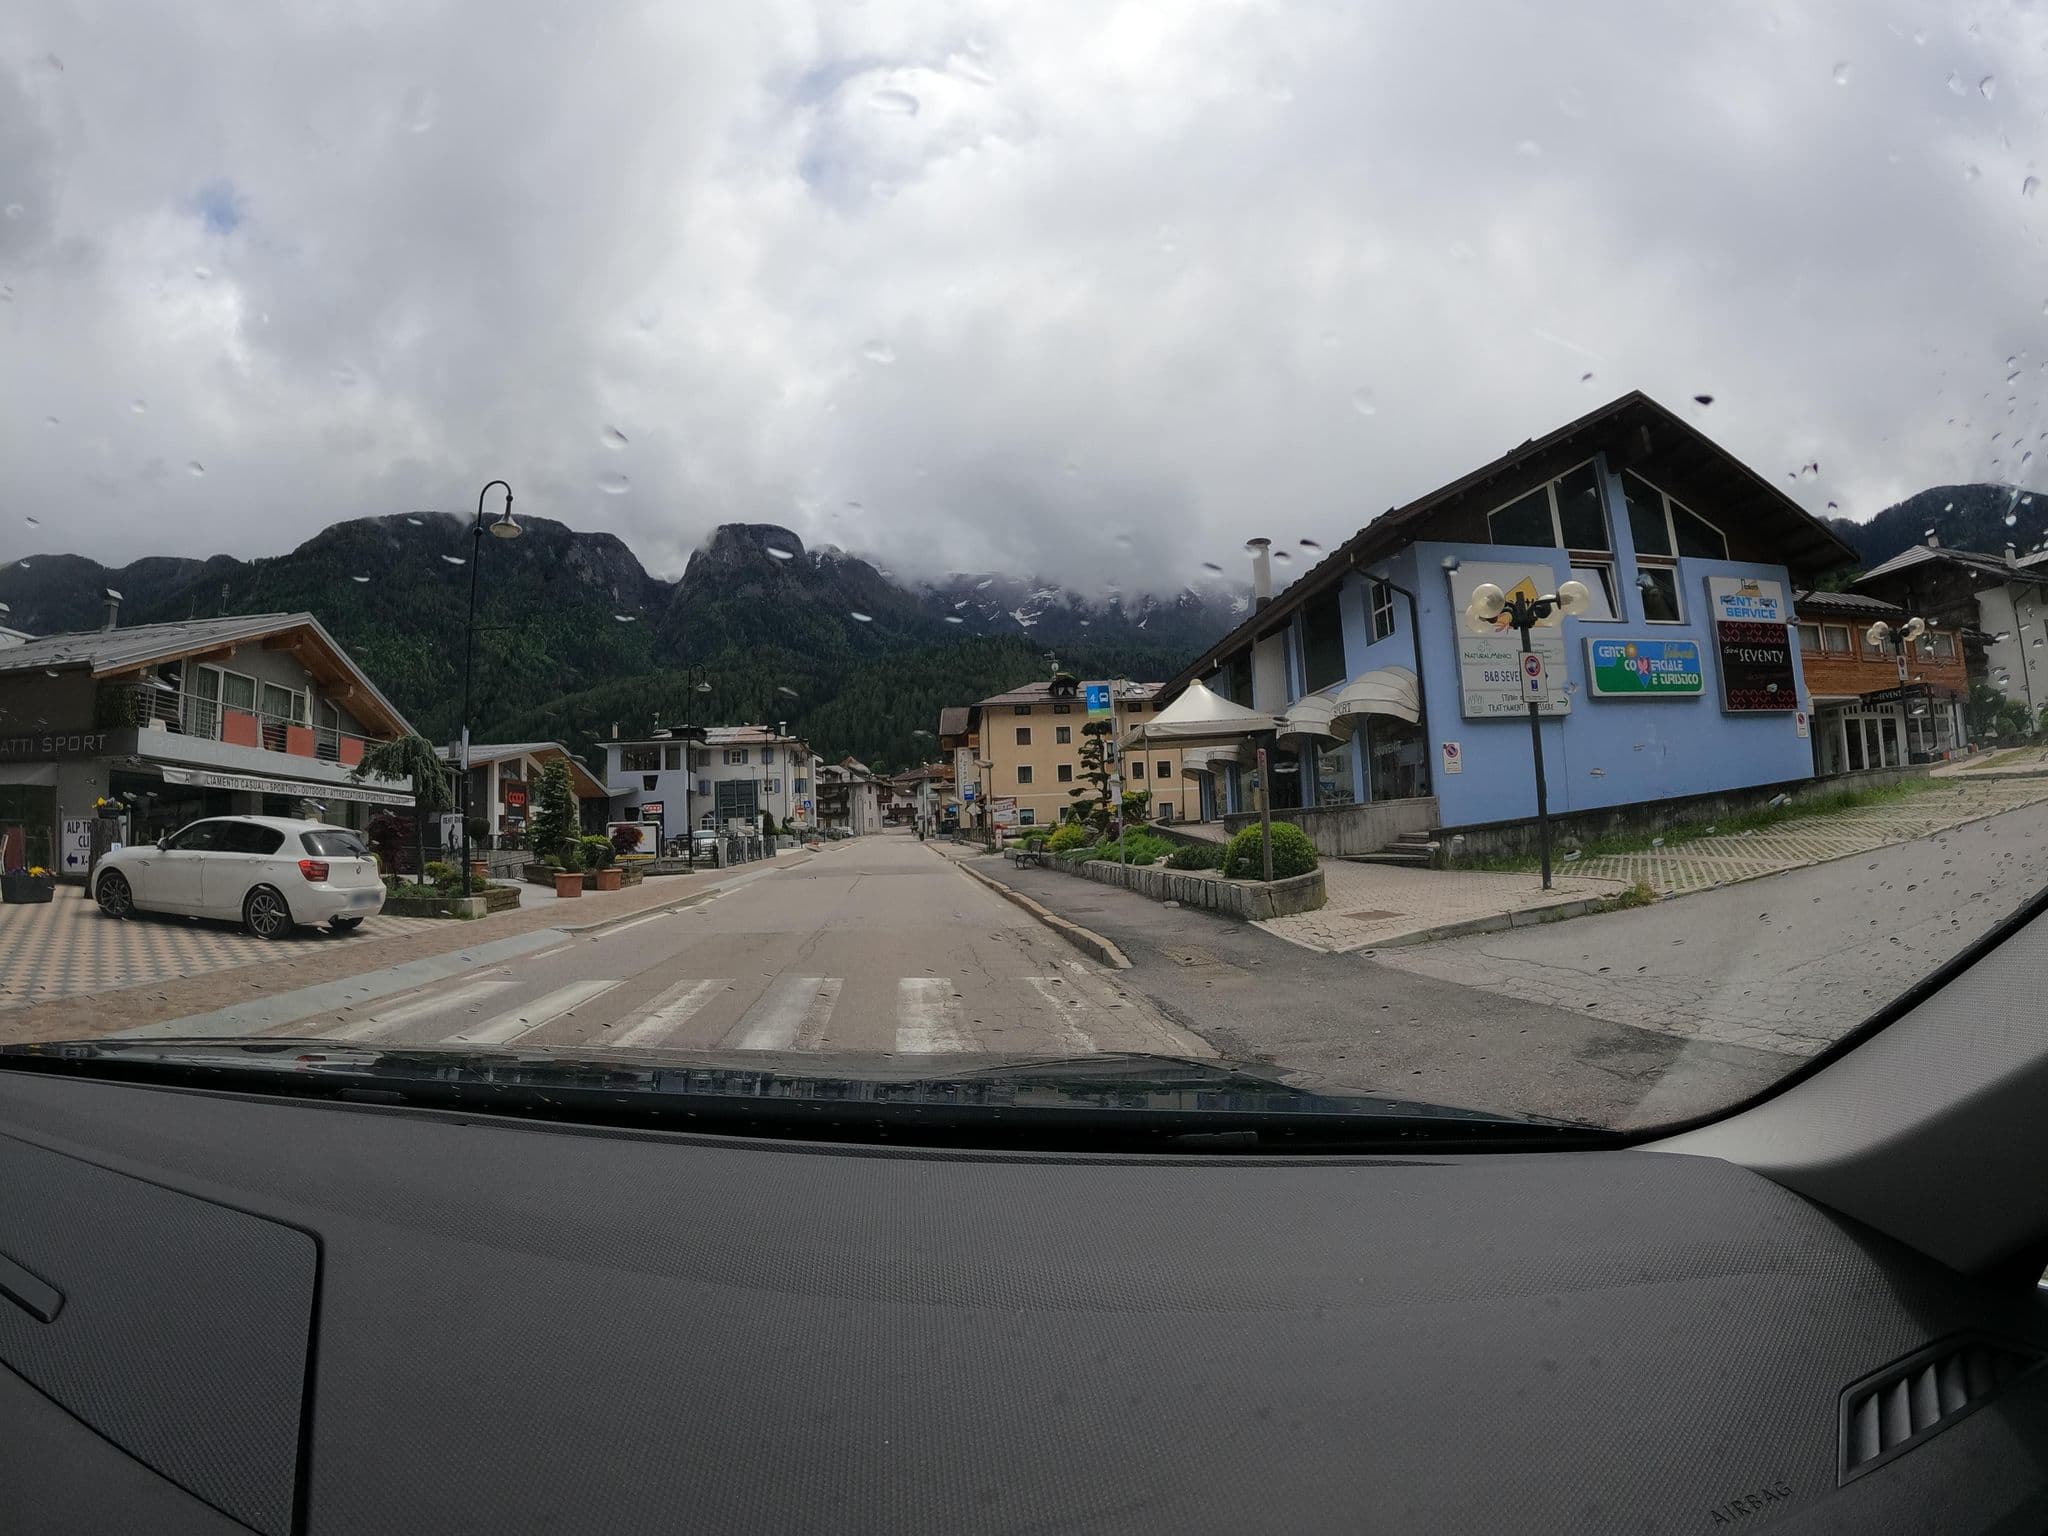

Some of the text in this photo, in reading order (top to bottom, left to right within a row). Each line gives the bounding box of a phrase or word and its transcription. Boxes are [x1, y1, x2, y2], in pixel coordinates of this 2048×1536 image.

[1726, 607, 1776, 619] SERVICE
[1739, 648, 1784, 664] SEVENTY
[1484, 670, 1499, 682] B&B
[42, 734, 107, 752] SPORT
[241, 778, 265, 791] CASUAL
[67, 821, 80, 834] ALP
[1711, 1480, 1793, 1529] AIRBAG
